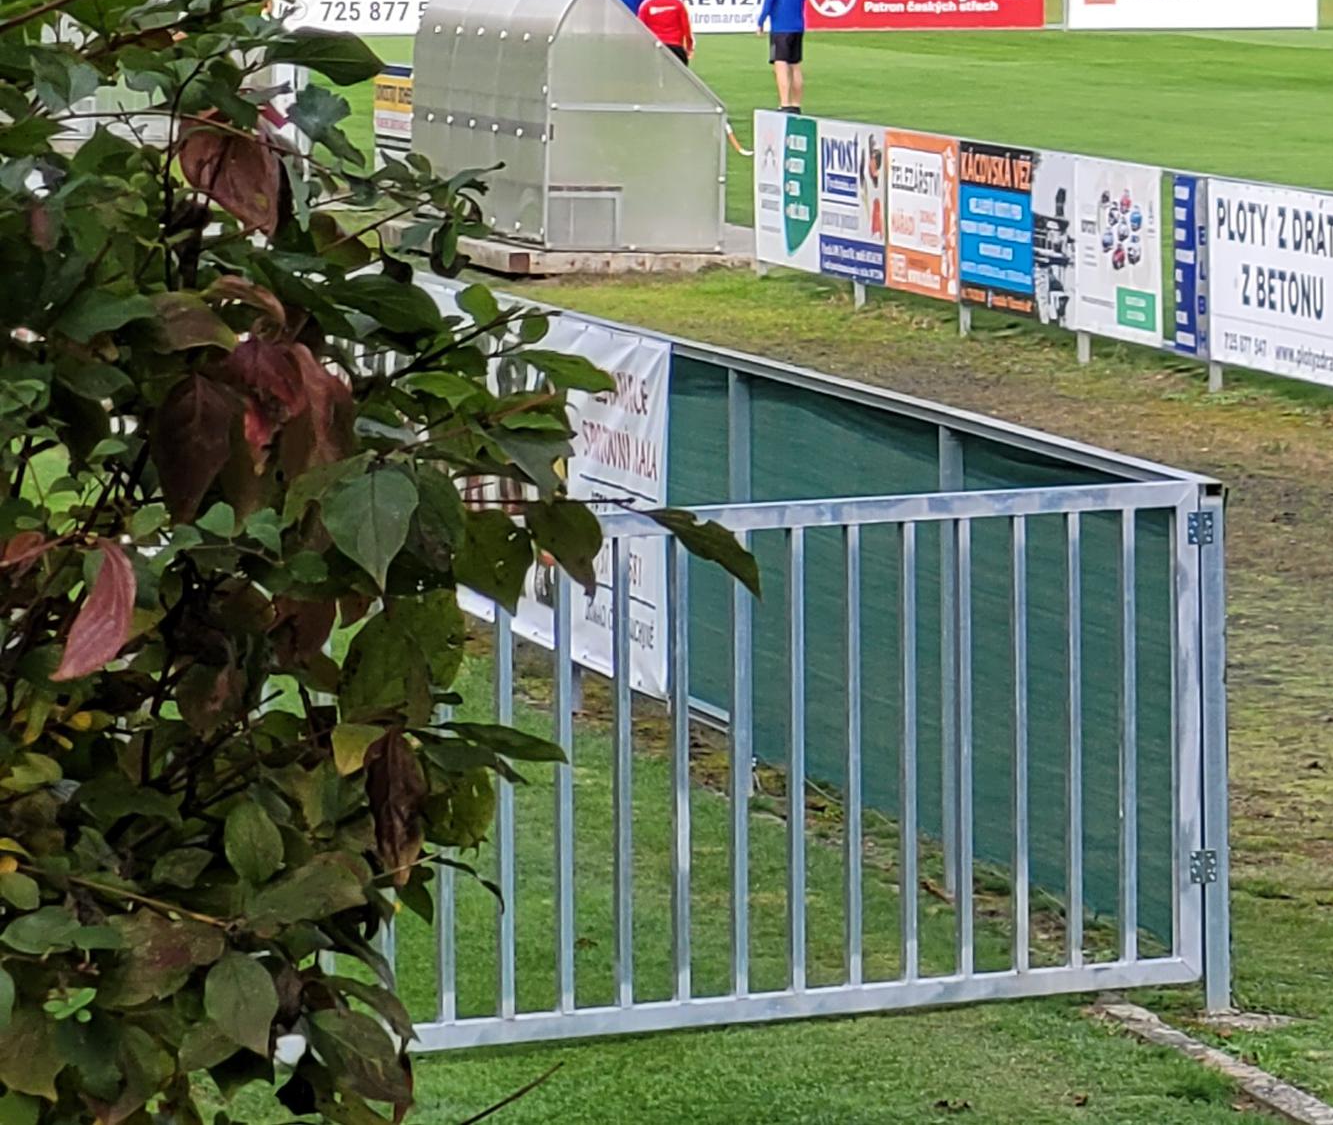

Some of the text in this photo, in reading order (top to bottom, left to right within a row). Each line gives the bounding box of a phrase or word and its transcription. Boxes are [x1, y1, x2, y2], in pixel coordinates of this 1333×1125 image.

[321, 1, 361, 21] 725
[369, 1, 409, 21] 877
[863, 1, 905, 13] Patron
[906, 0, 957, 14] českých
[821, 132, 859, 192] prost
[1217, 197, 1268, 246] PLOTY
[1278, 206, 1287, 249] Z
[1241, 264, 1324, 320] Z BETONU
